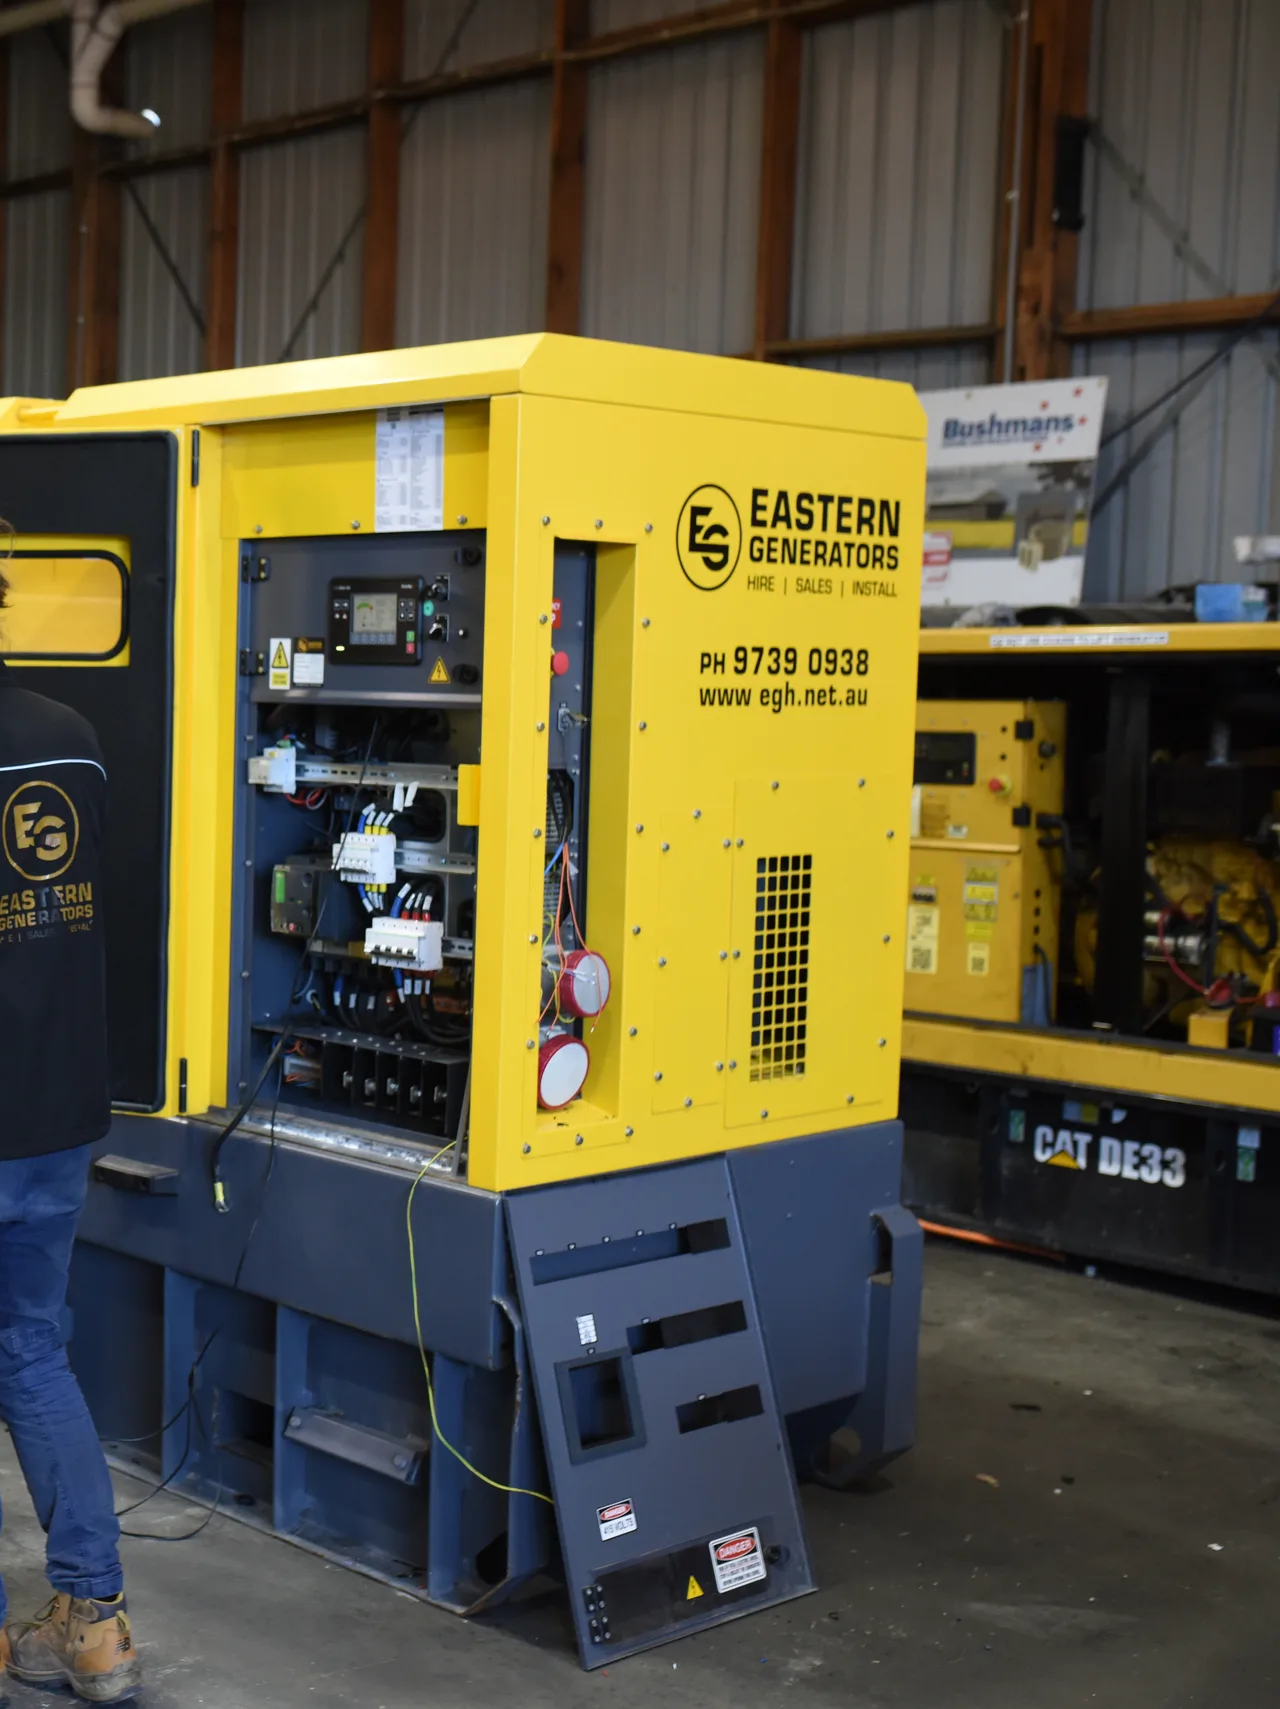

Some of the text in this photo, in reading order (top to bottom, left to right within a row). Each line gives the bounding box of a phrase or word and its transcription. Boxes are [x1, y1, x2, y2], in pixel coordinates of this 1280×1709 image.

[943, 412, 1074, 440] Bushmans
[750, 488, 901, 537] EASTERN
[749, 535, 899, 571] GENERATORS
[747, 576, 898, 598] HIRE SALES INSTALL
[700, 646, 869, 676] PH 9739 0938
[699, 681, 868, 714] www egh.net.au
[1034, 1125, 1186, 1188] CAT DE33
[718, 1539, 753, 1559] DANGER
